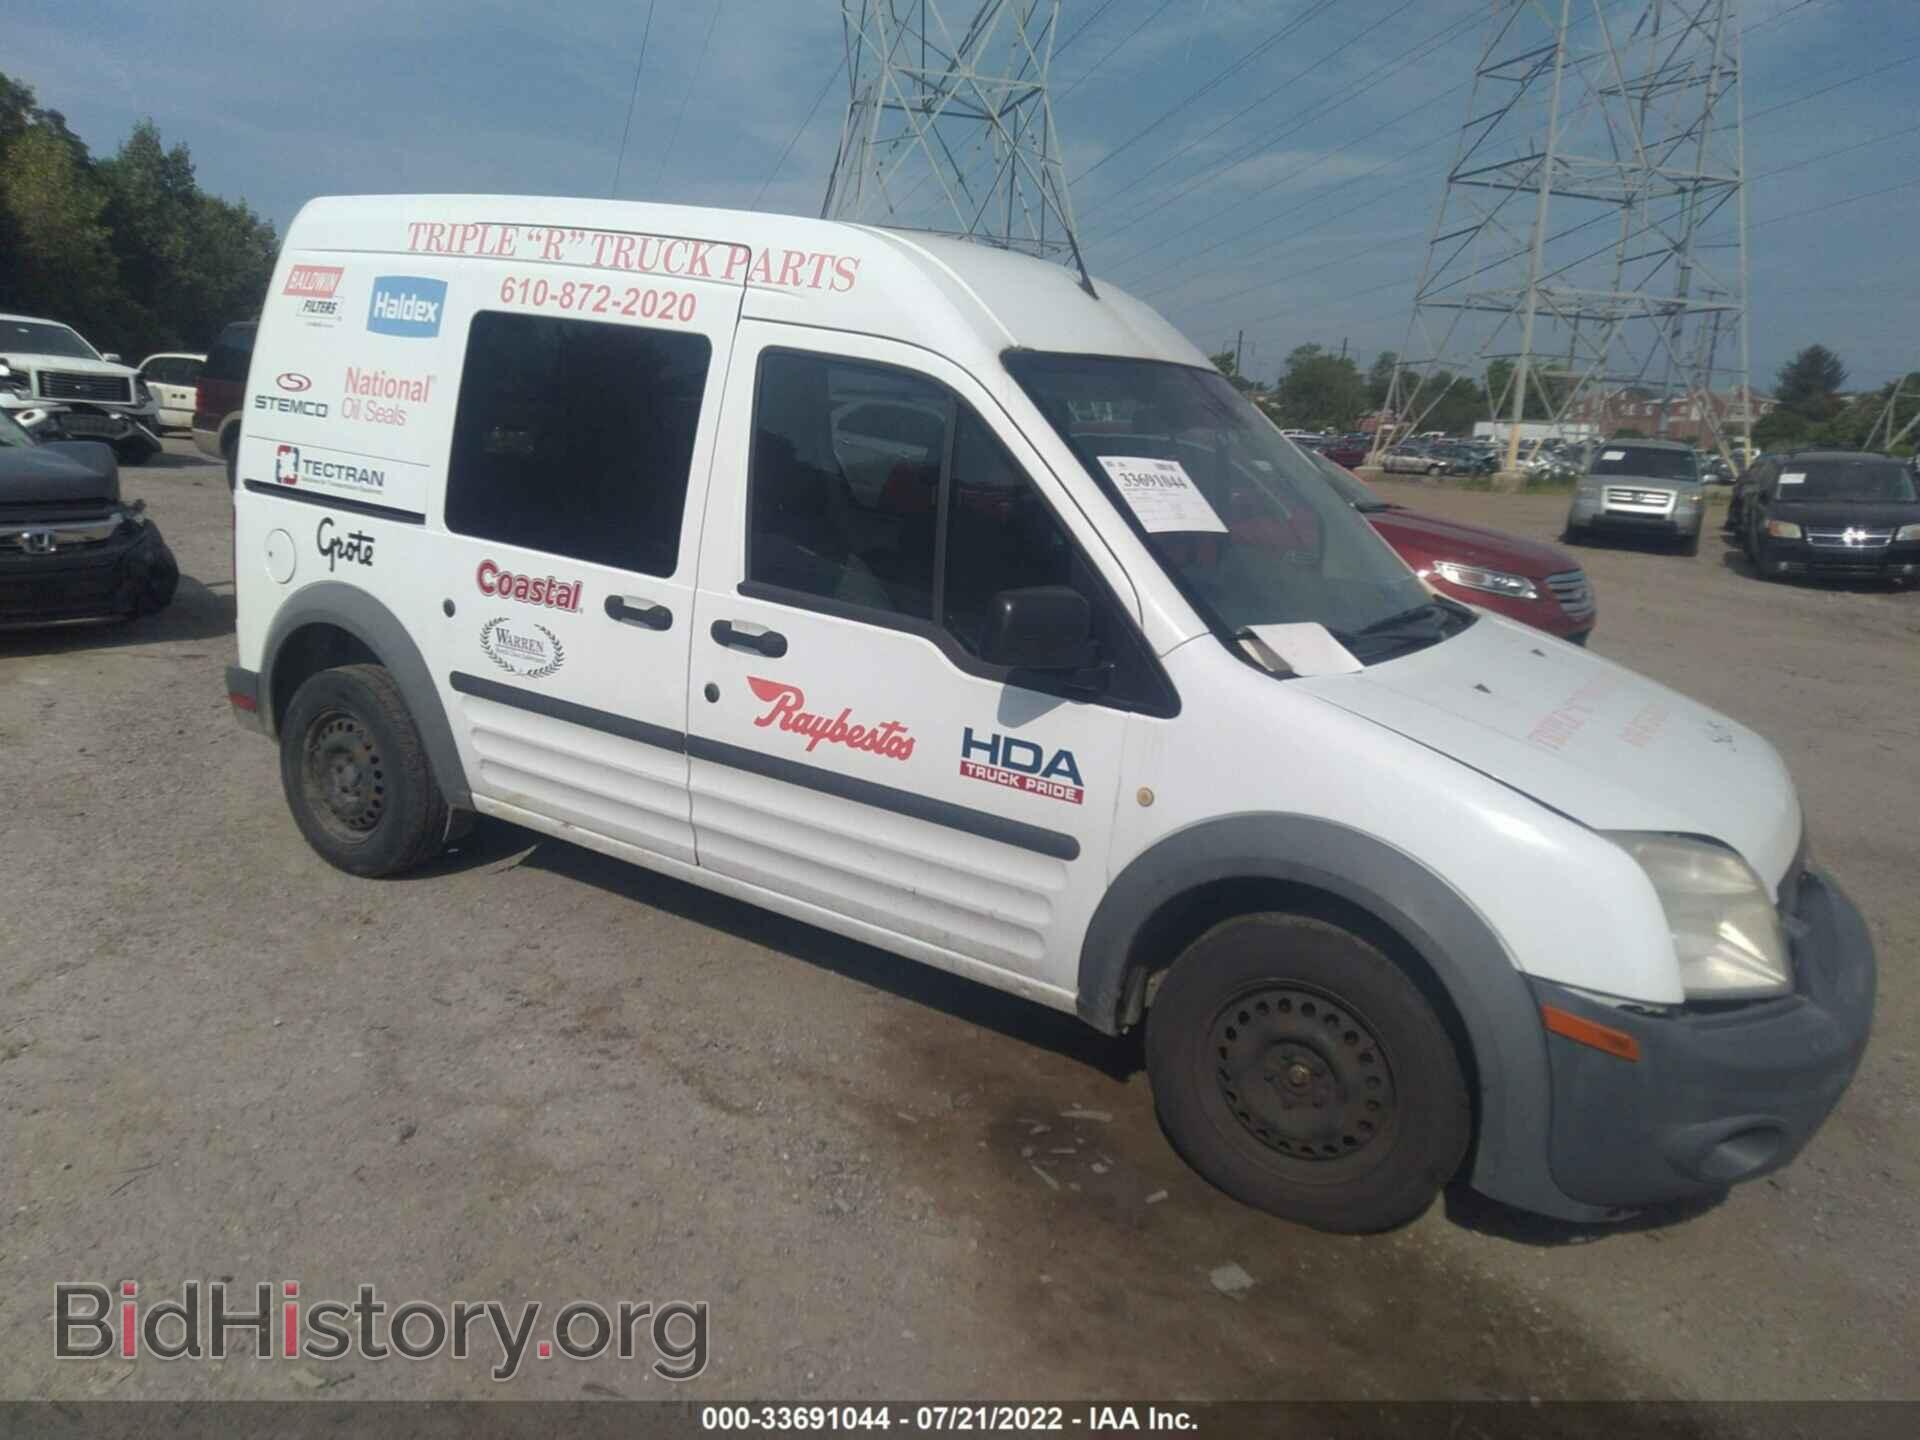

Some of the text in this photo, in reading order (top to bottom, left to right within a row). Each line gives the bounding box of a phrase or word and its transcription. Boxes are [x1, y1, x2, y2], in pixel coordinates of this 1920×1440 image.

[408, 222, 519, 257] TRIPLE
[591, 232, 713, 278] TRUCK
[720, 242, 862, 293] PARTS
[303, 299, 338, 315] FILTERS
[373, 290, 439, 323] Haldex
[499, 276, 697, 323] 610-872-2020
[344, 366, 433, 404] National
[254, 394, 328, 418] STEMCO
[364, 400, 407, 426] Seals
[303, 458, 385, 487] TECTRAN
[316, 516, 375, 572] Grote
[476, 559, 583, 613] Coastal
[746, 675, 916, 761] Raybestos
[962, 726, 1084, 787] HDA
[966, 762, 1079, 802] TRUCK PRIDE
